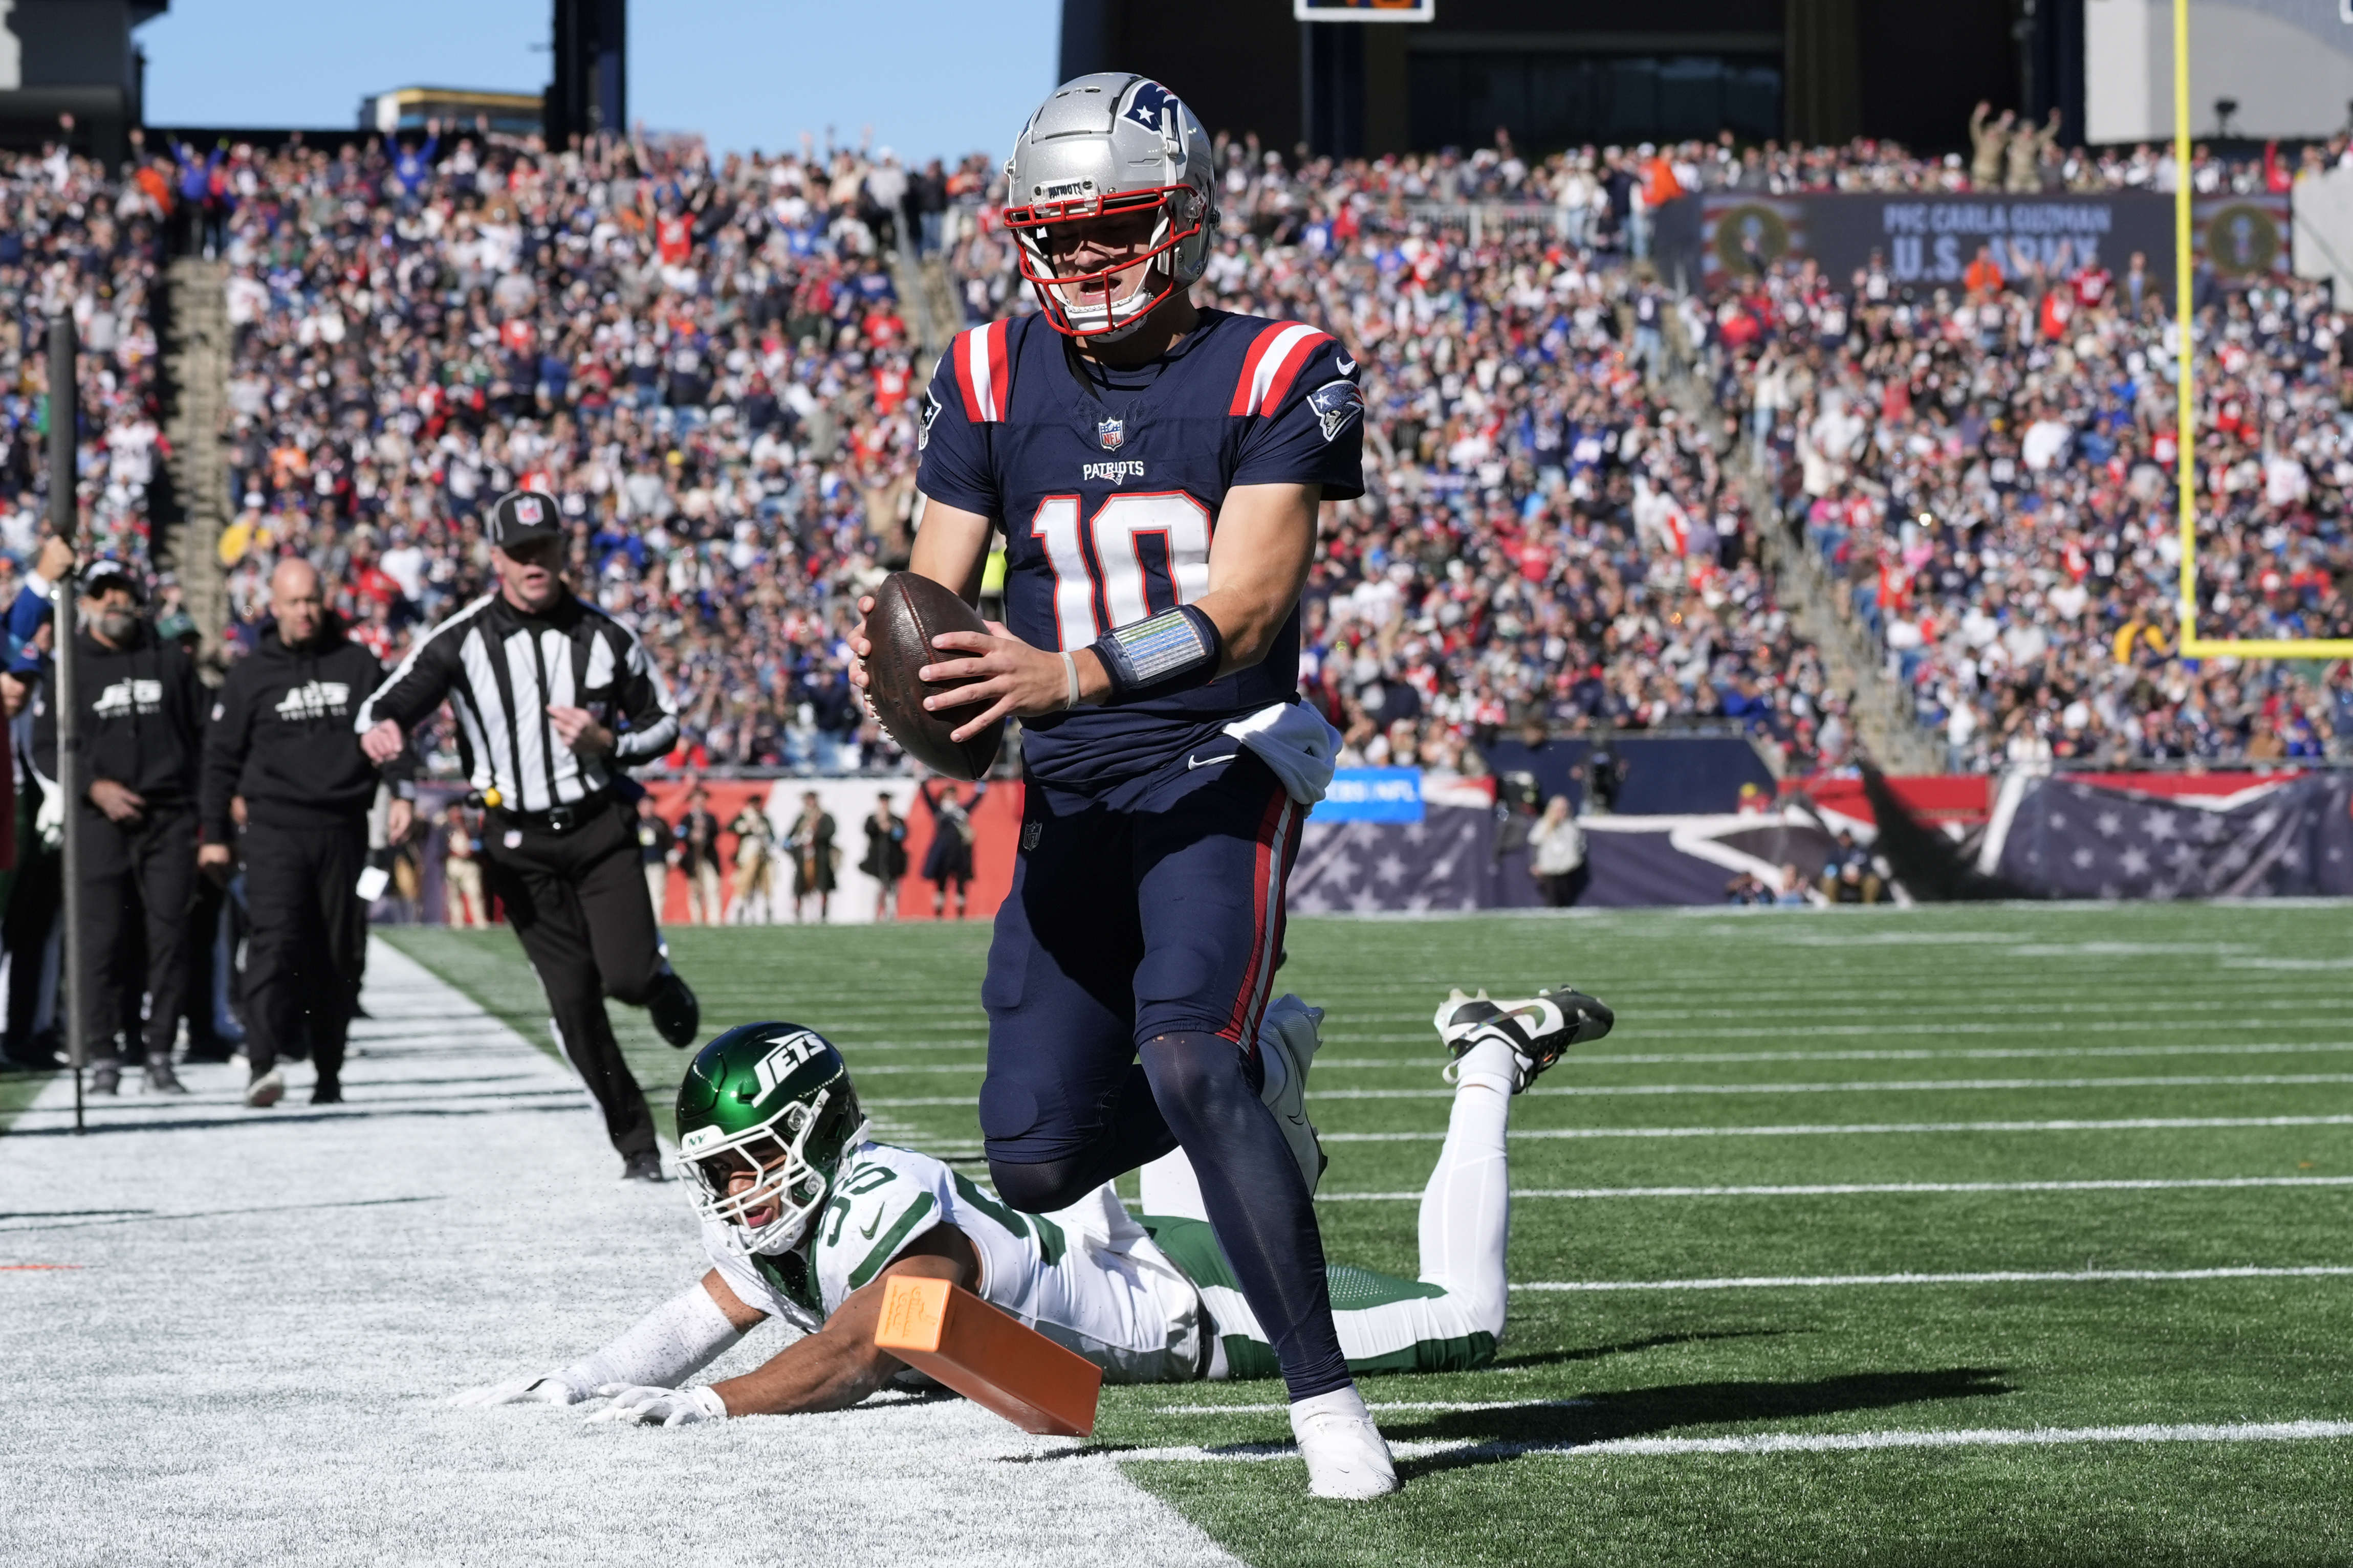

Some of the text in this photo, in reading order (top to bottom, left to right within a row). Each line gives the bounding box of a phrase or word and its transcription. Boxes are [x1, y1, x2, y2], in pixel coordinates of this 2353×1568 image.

[1103, 433, 1121, 446] NFL
[1083, 461, 1145, 481] PATRIOTS
[1031, 489, 1213, 652] 10
[751, 1030, 827, 1108] JETS
[689, 1133, 707, 1148] NY
